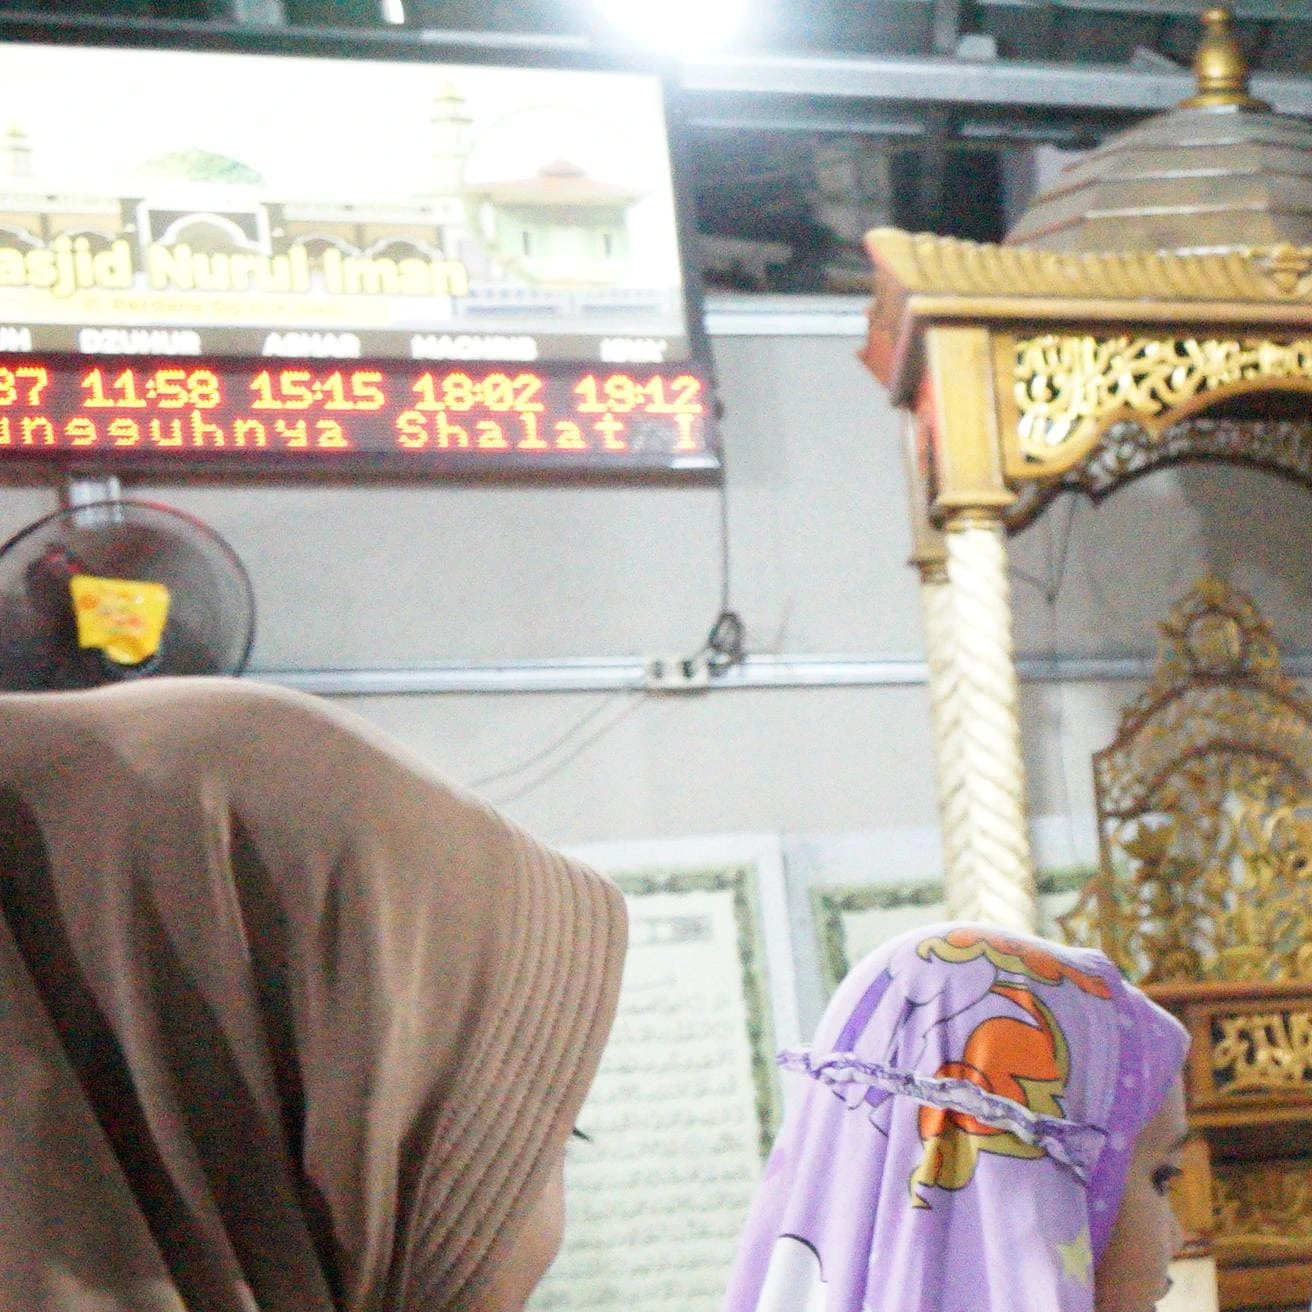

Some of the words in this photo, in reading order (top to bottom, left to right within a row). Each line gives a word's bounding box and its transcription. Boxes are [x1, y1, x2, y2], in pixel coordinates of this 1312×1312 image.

[147, 241, 311, 293] Nurul
[322, 247, 469, 297] Iman
[81, 367, 221, 409] 11:58
[250, 369, 386, 411] 15:15
[412, 372, 544, 413] 18:02
[574, 374, 704, 414] 19:12
[396, 410, 626, 450] Shalat
